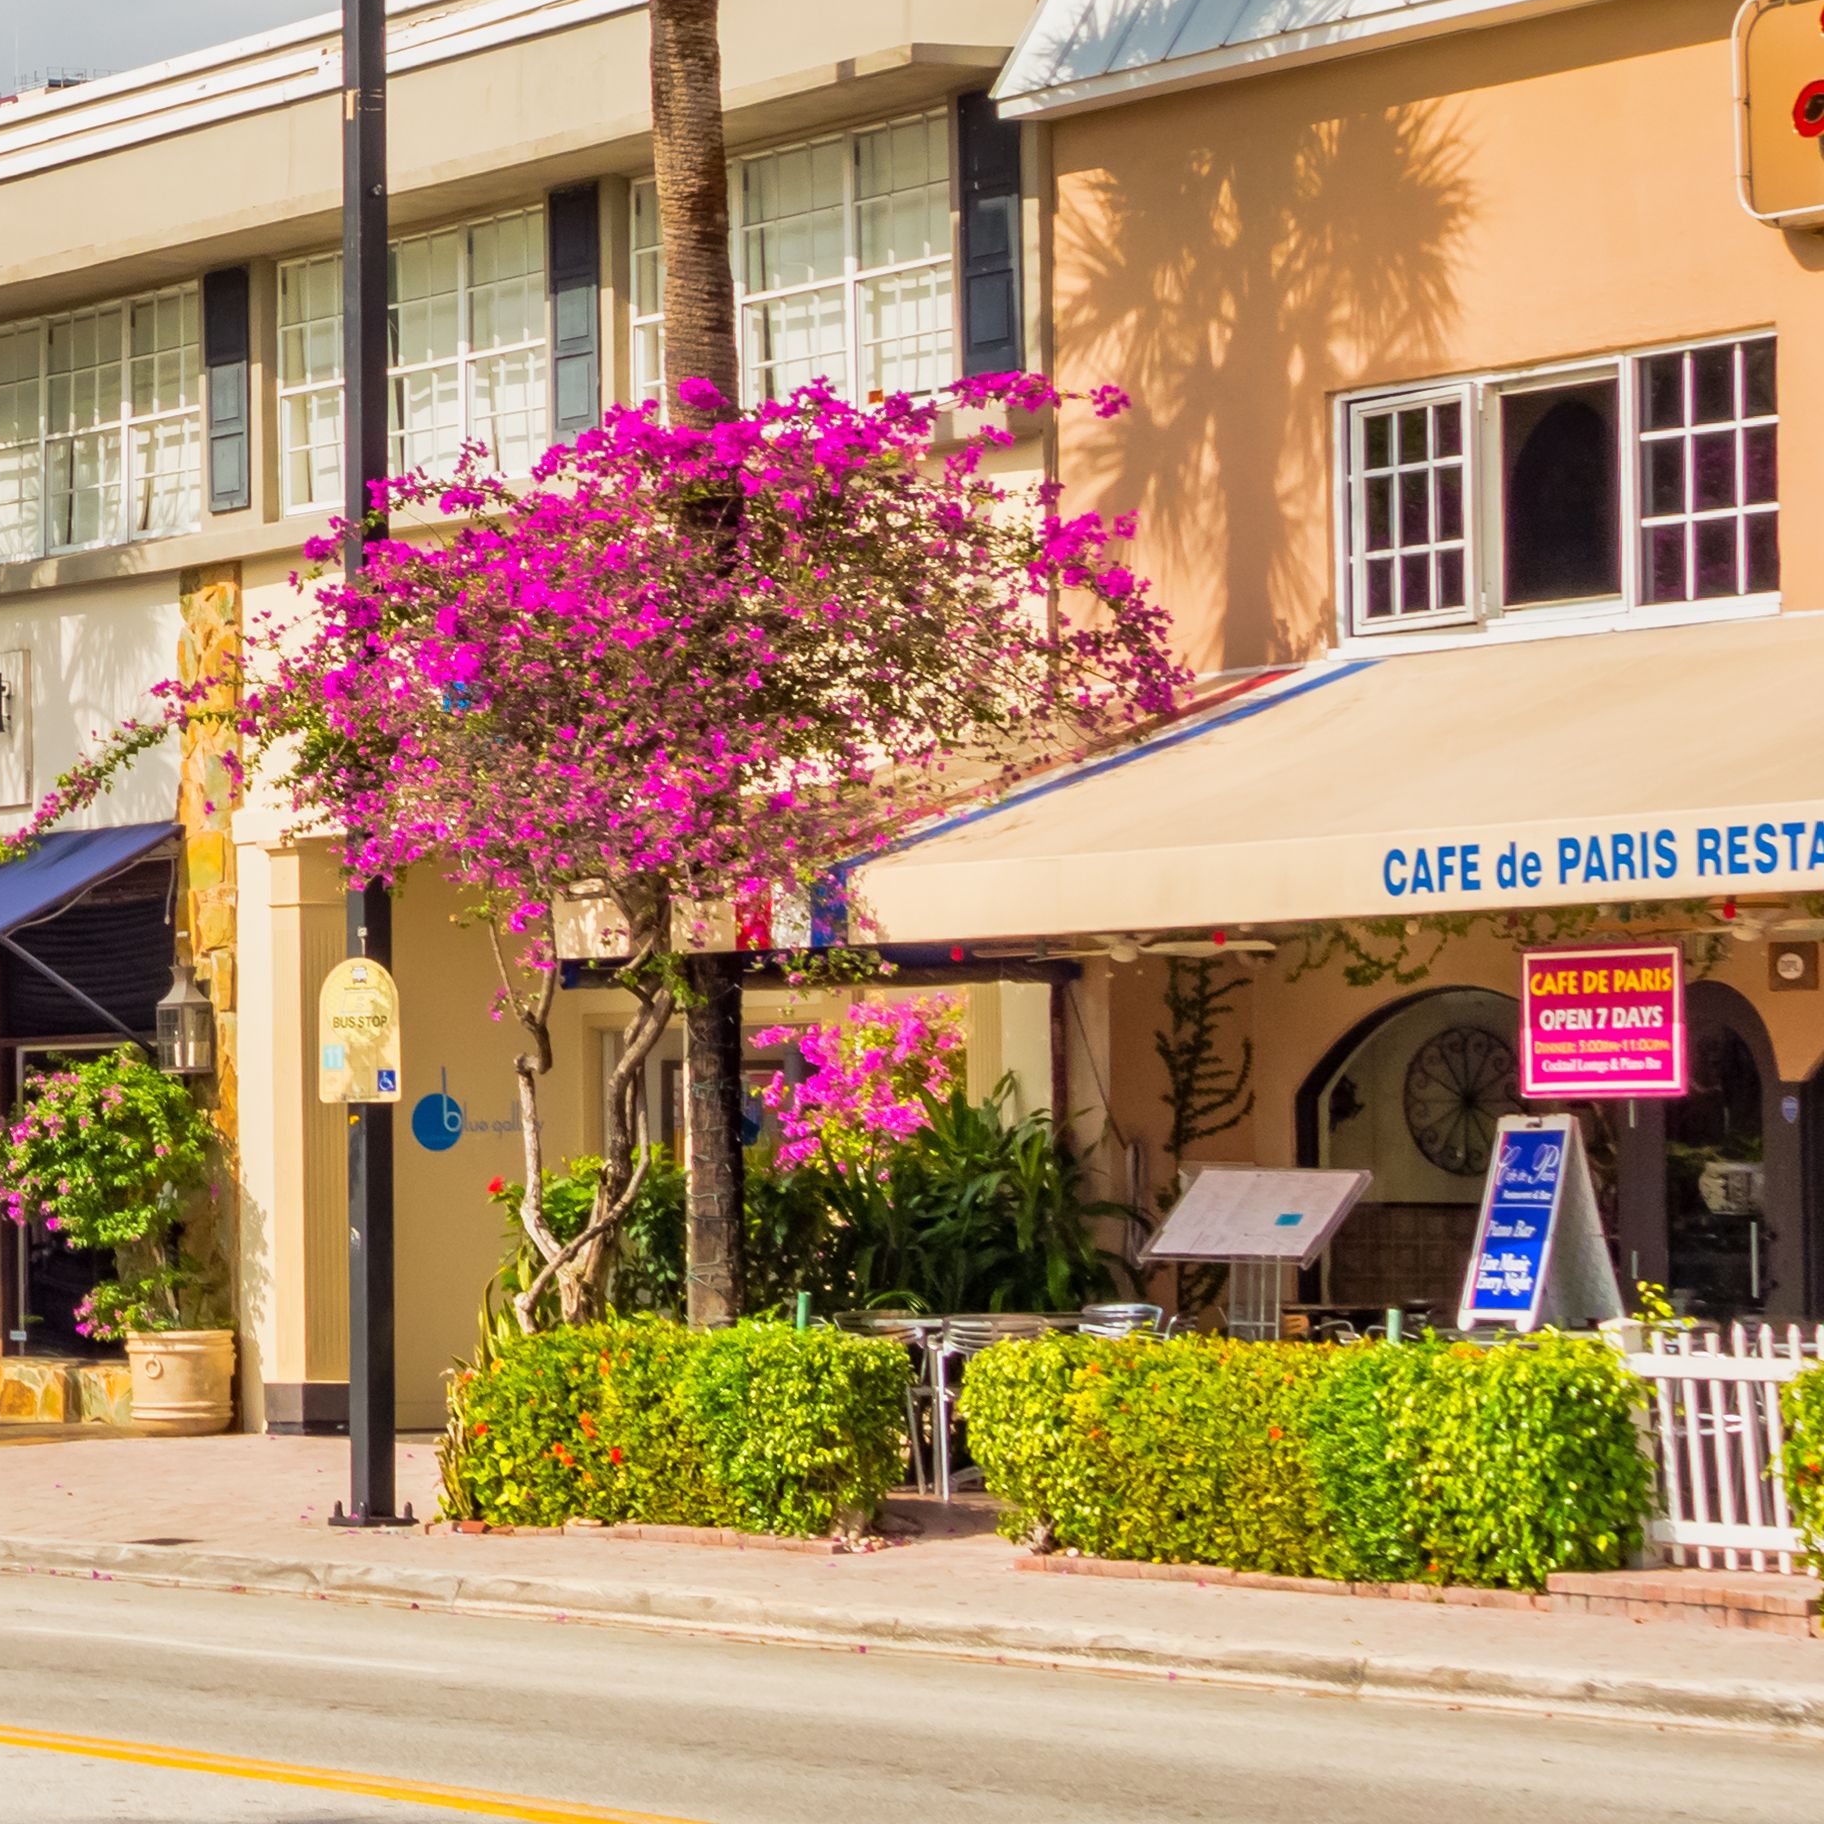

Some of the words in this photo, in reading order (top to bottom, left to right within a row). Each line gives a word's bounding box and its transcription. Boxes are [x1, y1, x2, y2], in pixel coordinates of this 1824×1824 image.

[1384, 845, 1481, 896] CAFE
[1497, 842, 1542, 889] de
[1558, 829, 1677, 885] PARIS
[1530, 971, 1578, 996] CAFE
[1582, 969, 1609, 994] DE
[1613, 967, 1673, 993] PARIS
[333, 1016, 356, 1029] BUS
[358, 1015, 388, 1029] STOP
[1539, 1008, 1593, 1031] OPEN
[1596, 1007, 1609, 1029] 7
[1612, 1005, 1663, 1029] DAYS
[1610, 1057, 1619, 1071] &
